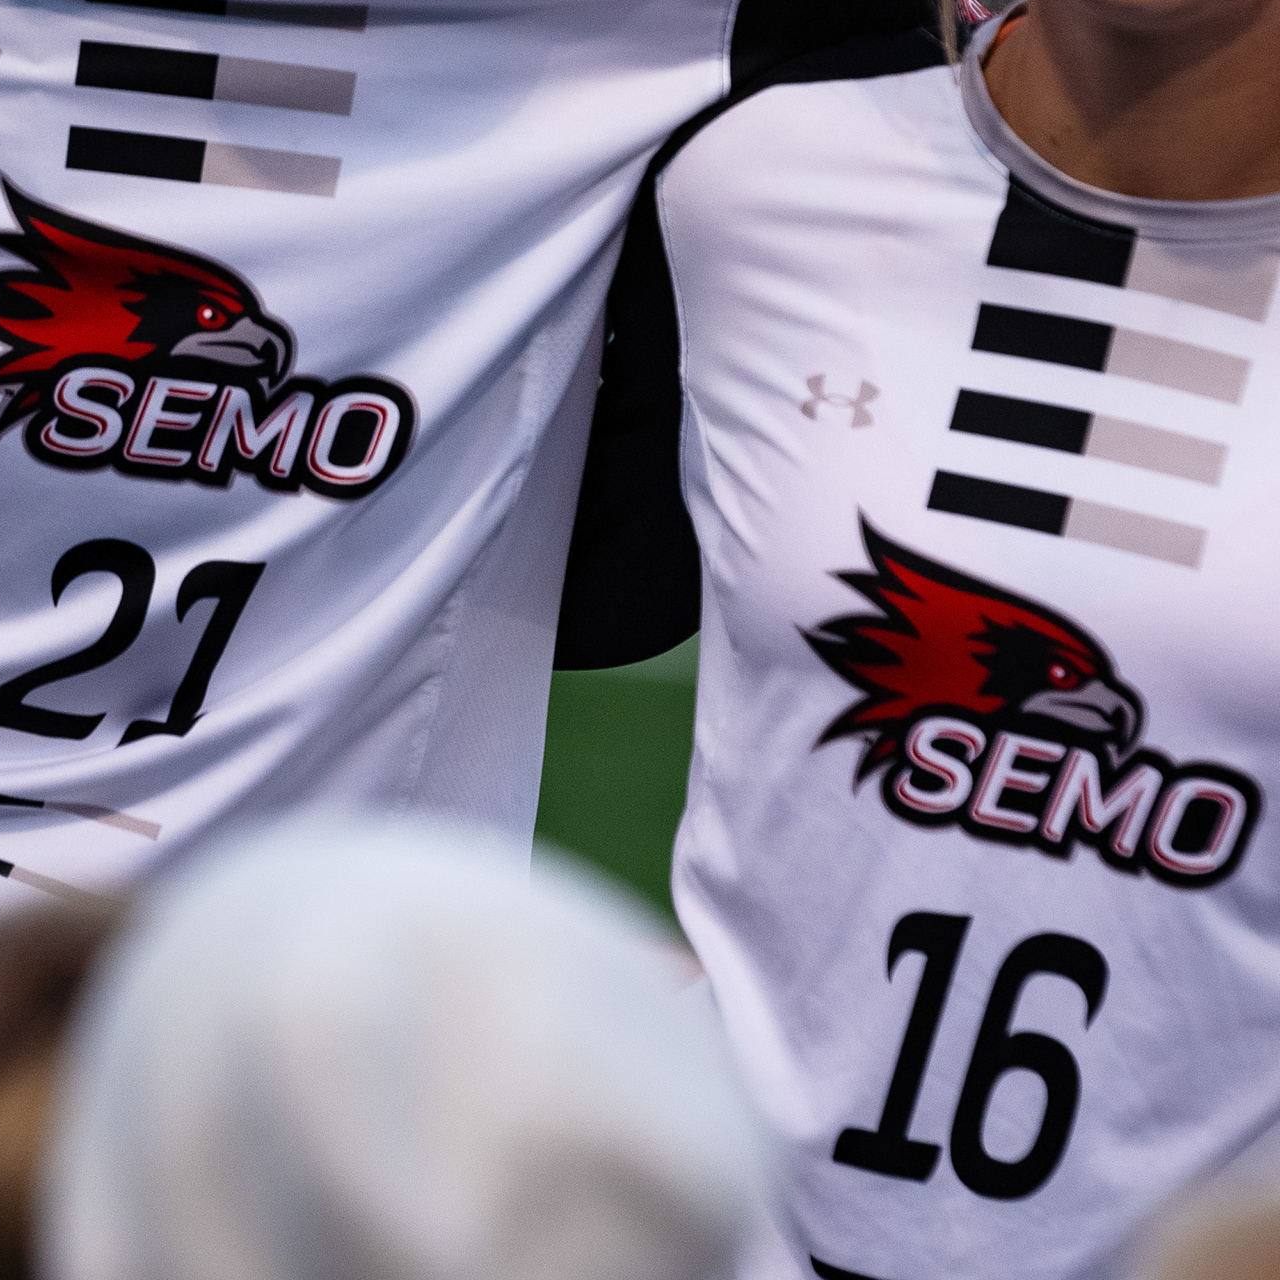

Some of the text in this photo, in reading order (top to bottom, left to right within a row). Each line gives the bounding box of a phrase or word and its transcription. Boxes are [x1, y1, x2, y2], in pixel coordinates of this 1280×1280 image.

[40, 366, 403, 487] SEMO
[894, 715, 1249, 876] SEMO
[832, 910, 1111, 1202] 16
